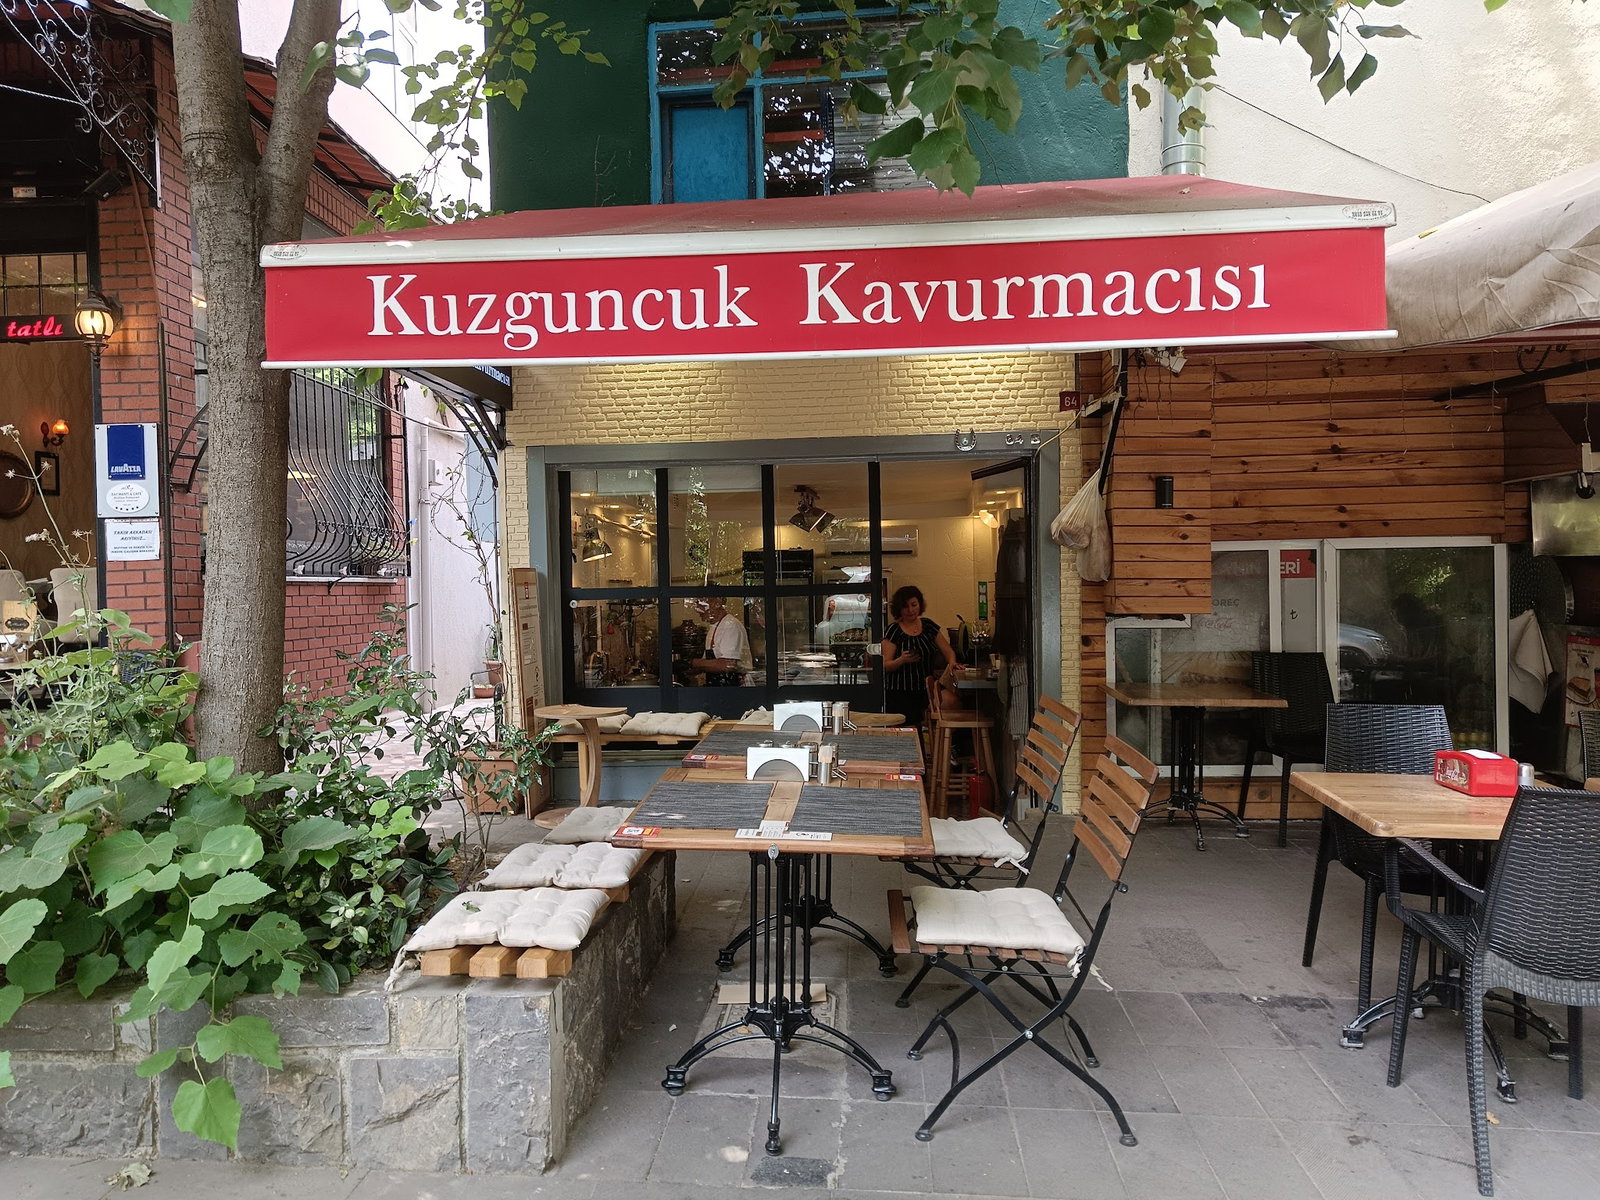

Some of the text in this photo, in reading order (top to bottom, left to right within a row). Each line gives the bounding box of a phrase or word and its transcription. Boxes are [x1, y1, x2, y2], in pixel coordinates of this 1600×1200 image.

[366, 262, 1271, 351] Kuzguncuk Kavurmacısı
[7, 316, 63, 337] tatlı
[1064, 396, 1077, 407] 64
[1005, 433, 1024, 445] 64
[110, 463, 142, 473] LAVAZZA
